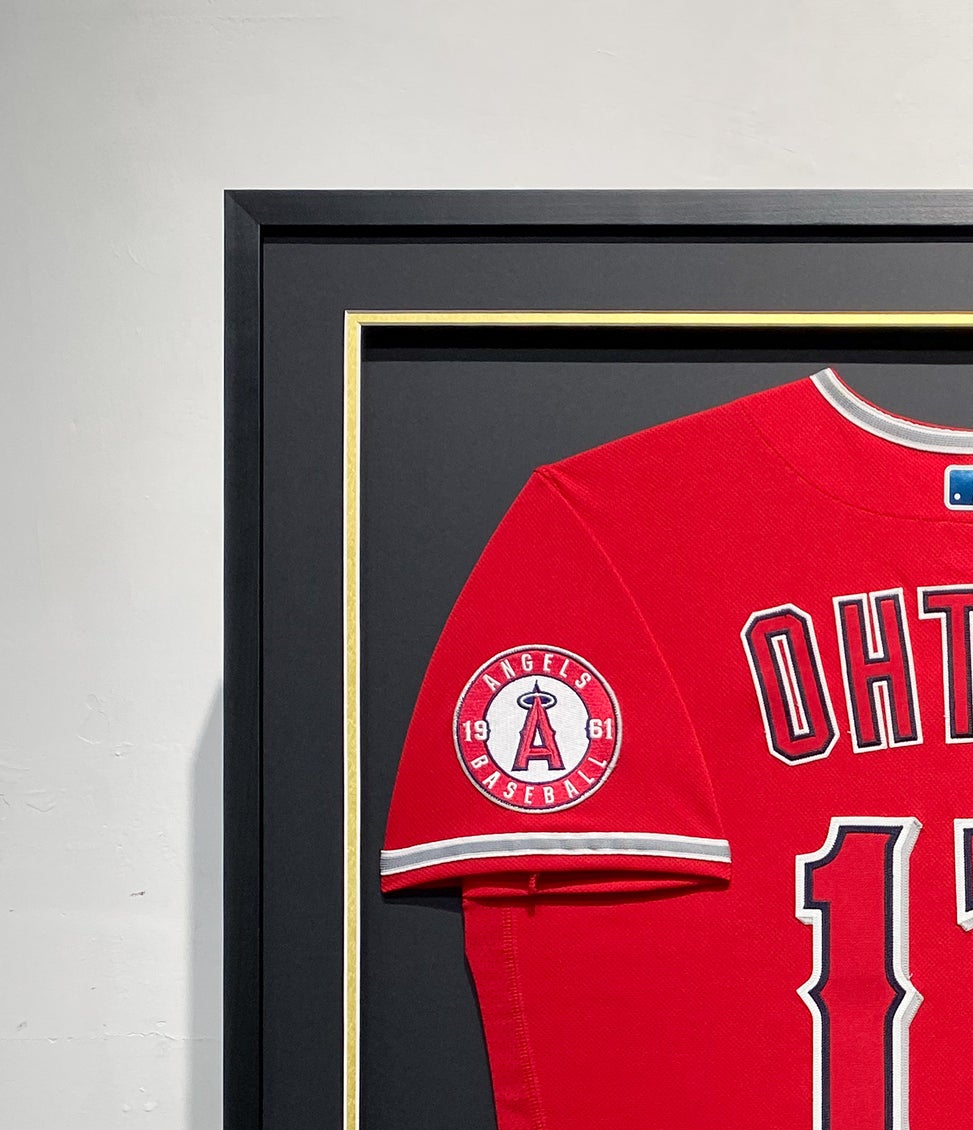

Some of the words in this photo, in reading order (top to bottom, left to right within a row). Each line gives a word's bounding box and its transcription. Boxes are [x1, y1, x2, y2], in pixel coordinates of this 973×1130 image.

[482, 653, 592, 693] ANGELS
[462, 719, 488, 742] 19
[588, 717, 613, 740] 61
[470, 754, 607, 804] BASEBALL
